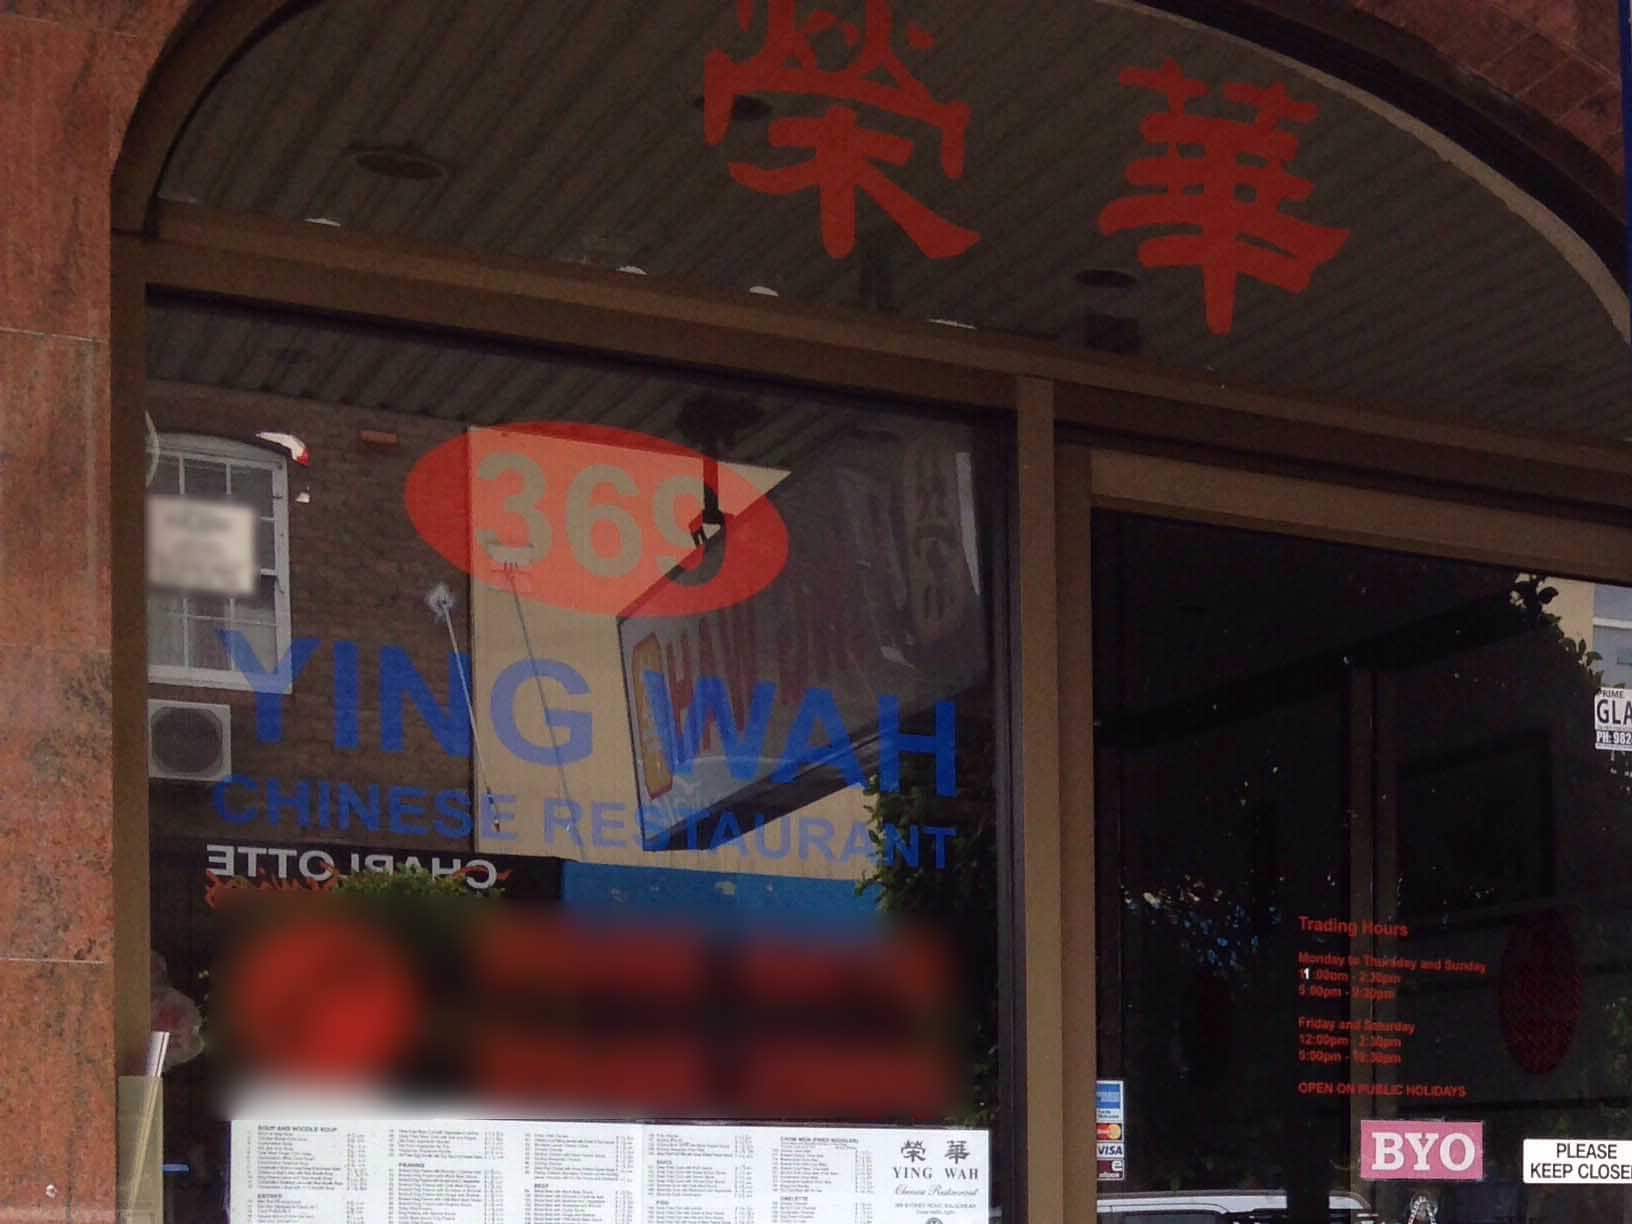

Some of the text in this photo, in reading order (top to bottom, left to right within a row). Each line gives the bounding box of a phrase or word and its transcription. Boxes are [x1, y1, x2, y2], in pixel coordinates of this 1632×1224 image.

[476, 452, 728, 588] 369
[214, 629, 960, 798] YING WAH
[213, 775, 957, 870] CHINESE RESTAURANT
[1298, 915, 1409, 937] Trading Hours
[1298, 951, 1345, 968] Monday
[1363, 954, 1417, 971] Thursday
[1420, 958, 1442, 970] and
[1444, 959, 1488, 974] Sunday
[1298, 1016, 1336, 1032] Friday
[1363, 1018, 1416, 1035] Saturday
[1298, 1082, 1468, 1098] OPEN ON PUBLIC HOLIDAYS
[1098, 1145, 1123, 1156] VISA
[1371, 1131, 1476, 1173] BYO
[1556, 1143, 1618, 1161] PLEASE
[893, 1166, 979, 1180] YING WAH
[1530, 1163, 1574, 1180] KEEP
